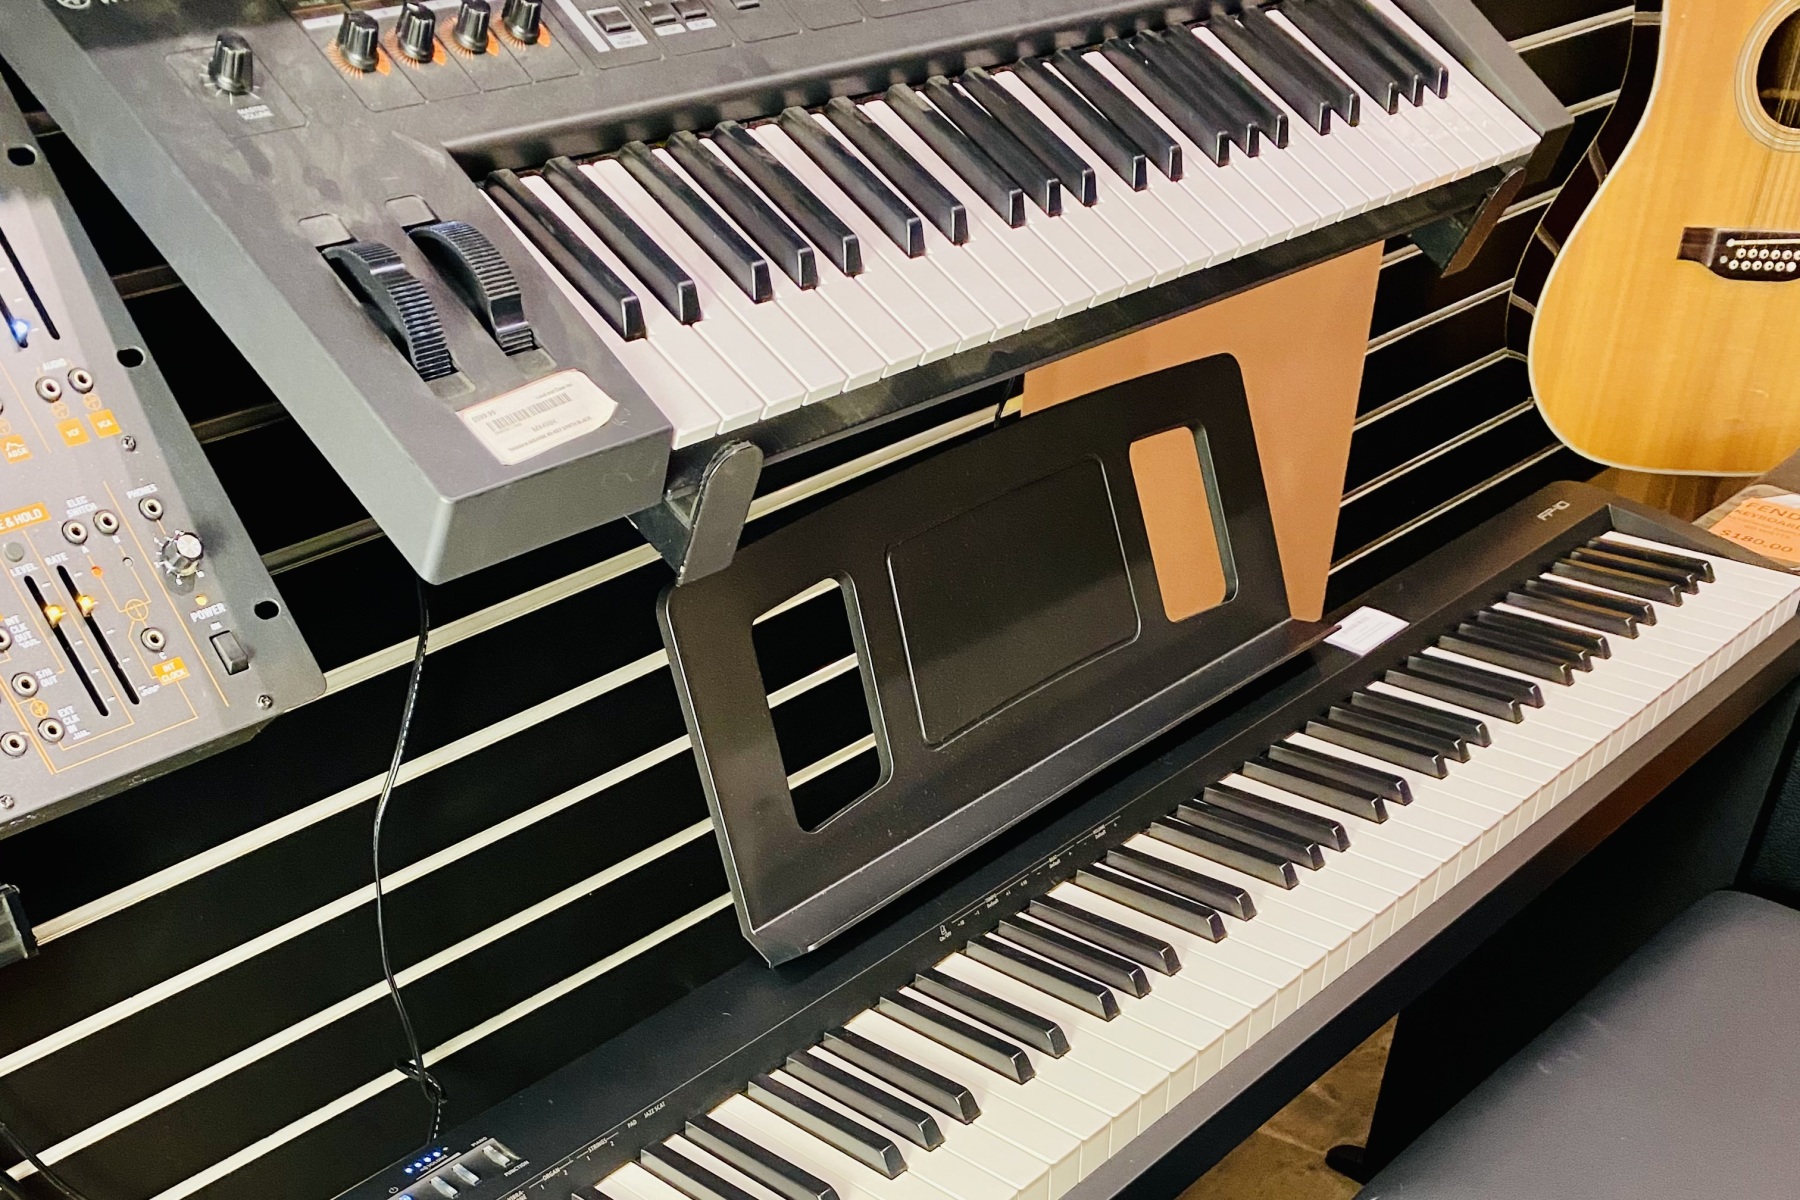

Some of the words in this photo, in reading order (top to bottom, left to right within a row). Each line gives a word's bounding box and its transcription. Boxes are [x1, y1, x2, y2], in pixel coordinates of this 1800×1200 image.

[126, 483, 158, 499] PHONES
[66, 495, 88, 508] ELEC
[13, 508, 43, 524] HOLD
[66, 502, 98, 518] SWITCH
[1720, 529, 1793, 553] $180.00
[45, 552, 69, 566] RATE
[10, 562, 38, 577] LEVEL
[190, 603, 226, 622] POWER
[14, 631, 33, 643] OUT
[40, 675, 58, 687] OUT
[161, 668, 186, 683] CLOCK
[643, 1107, 656, 1119] JAZZ
[654, 1101, 666, 1112] SCAT
[627, 1119, 637, 1129] PAD
[587, 1138, 608, 1153] STRINGS
[504, 1160, 530, 1177] FUNCTION
[542, 1167, 561, 1181] ORGAN
